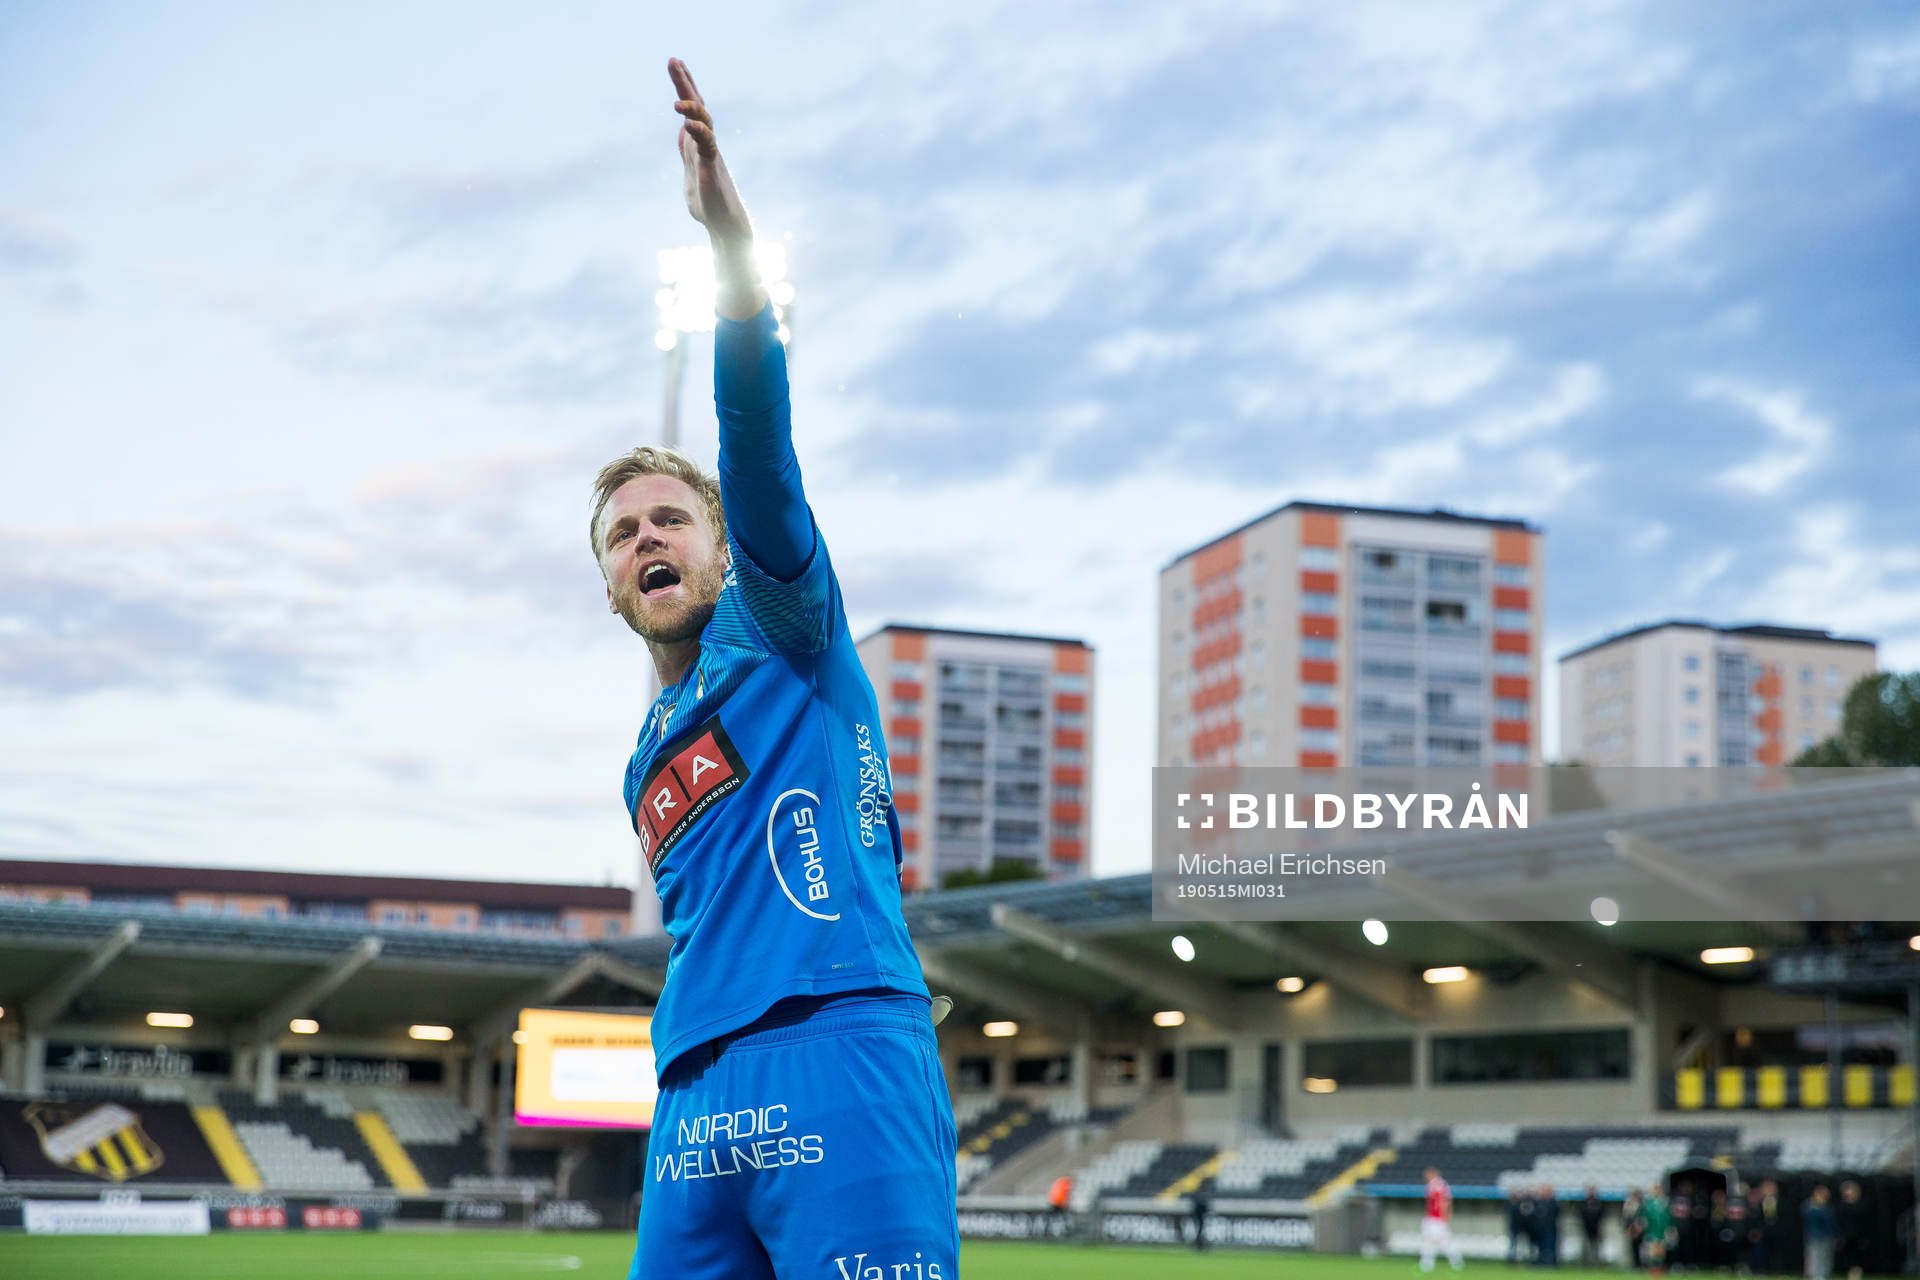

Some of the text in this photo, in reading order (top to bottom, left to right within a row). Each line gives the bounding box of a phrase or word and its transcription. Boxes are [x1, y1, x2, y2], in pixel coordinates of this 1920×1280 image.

[664, 820, 688, 849] RIEMER
[688, 777, 740, 823] ANDERSSON
[855, 723, 877, 848] GRÖNSAKS
[793, 807, 829, 902] BOHUS
[655, 1134, 824, 1182] WELLNESS
[677, 1103, 788, 1146] NORDIC
